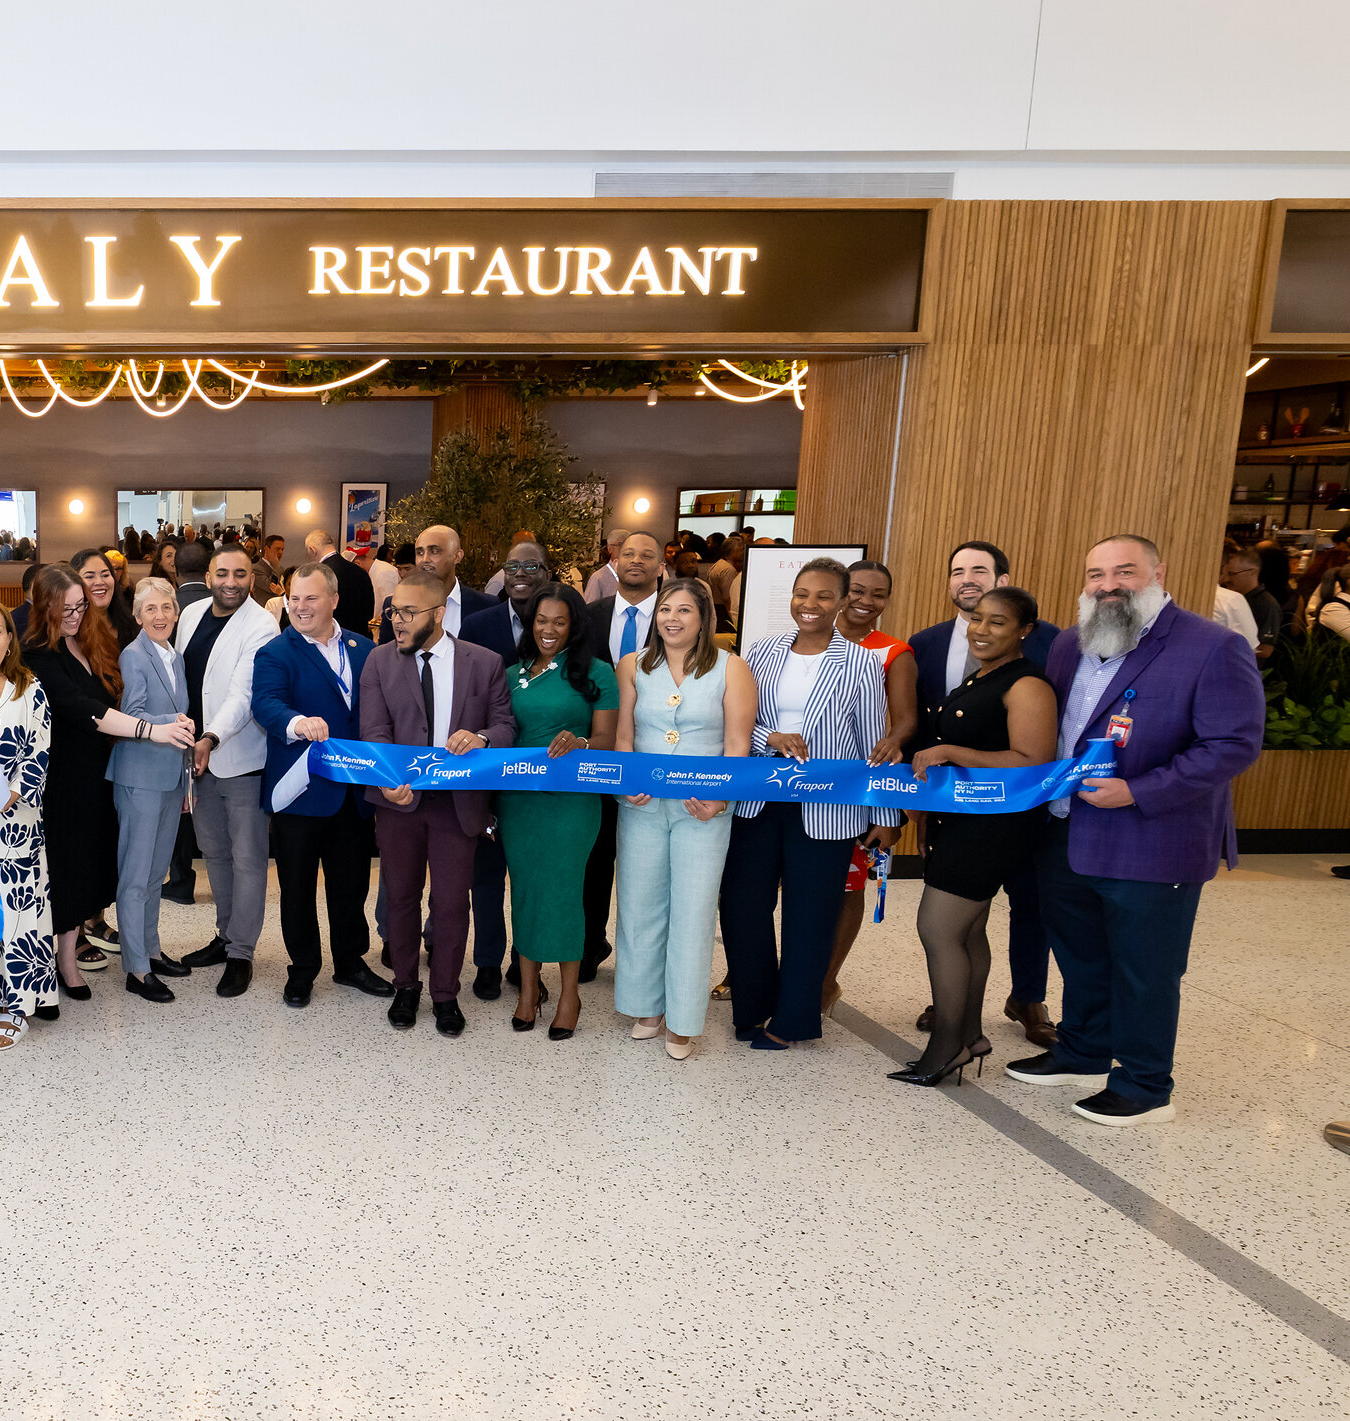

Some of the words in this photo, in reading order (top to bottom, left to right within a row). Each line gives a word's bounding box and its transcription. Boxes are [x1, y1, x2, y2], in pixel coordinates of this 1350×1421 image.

[308, 245, 758, 297] RESTAURANT
[779, 561, 804, 569] EAT
[342, 756, 377, 767] Kennedy
[1081, 760, 1118, 772] Kenned
[433, 768, 472, 779] Fraport
[501, 761, 547, 777] jetBlue
[666, 771, 687, 779] John
[695, 772, 733, 782] Kennedy
[794, 780, 834, 793] Fraport
[866, 776, 919, 794] jetBlue
